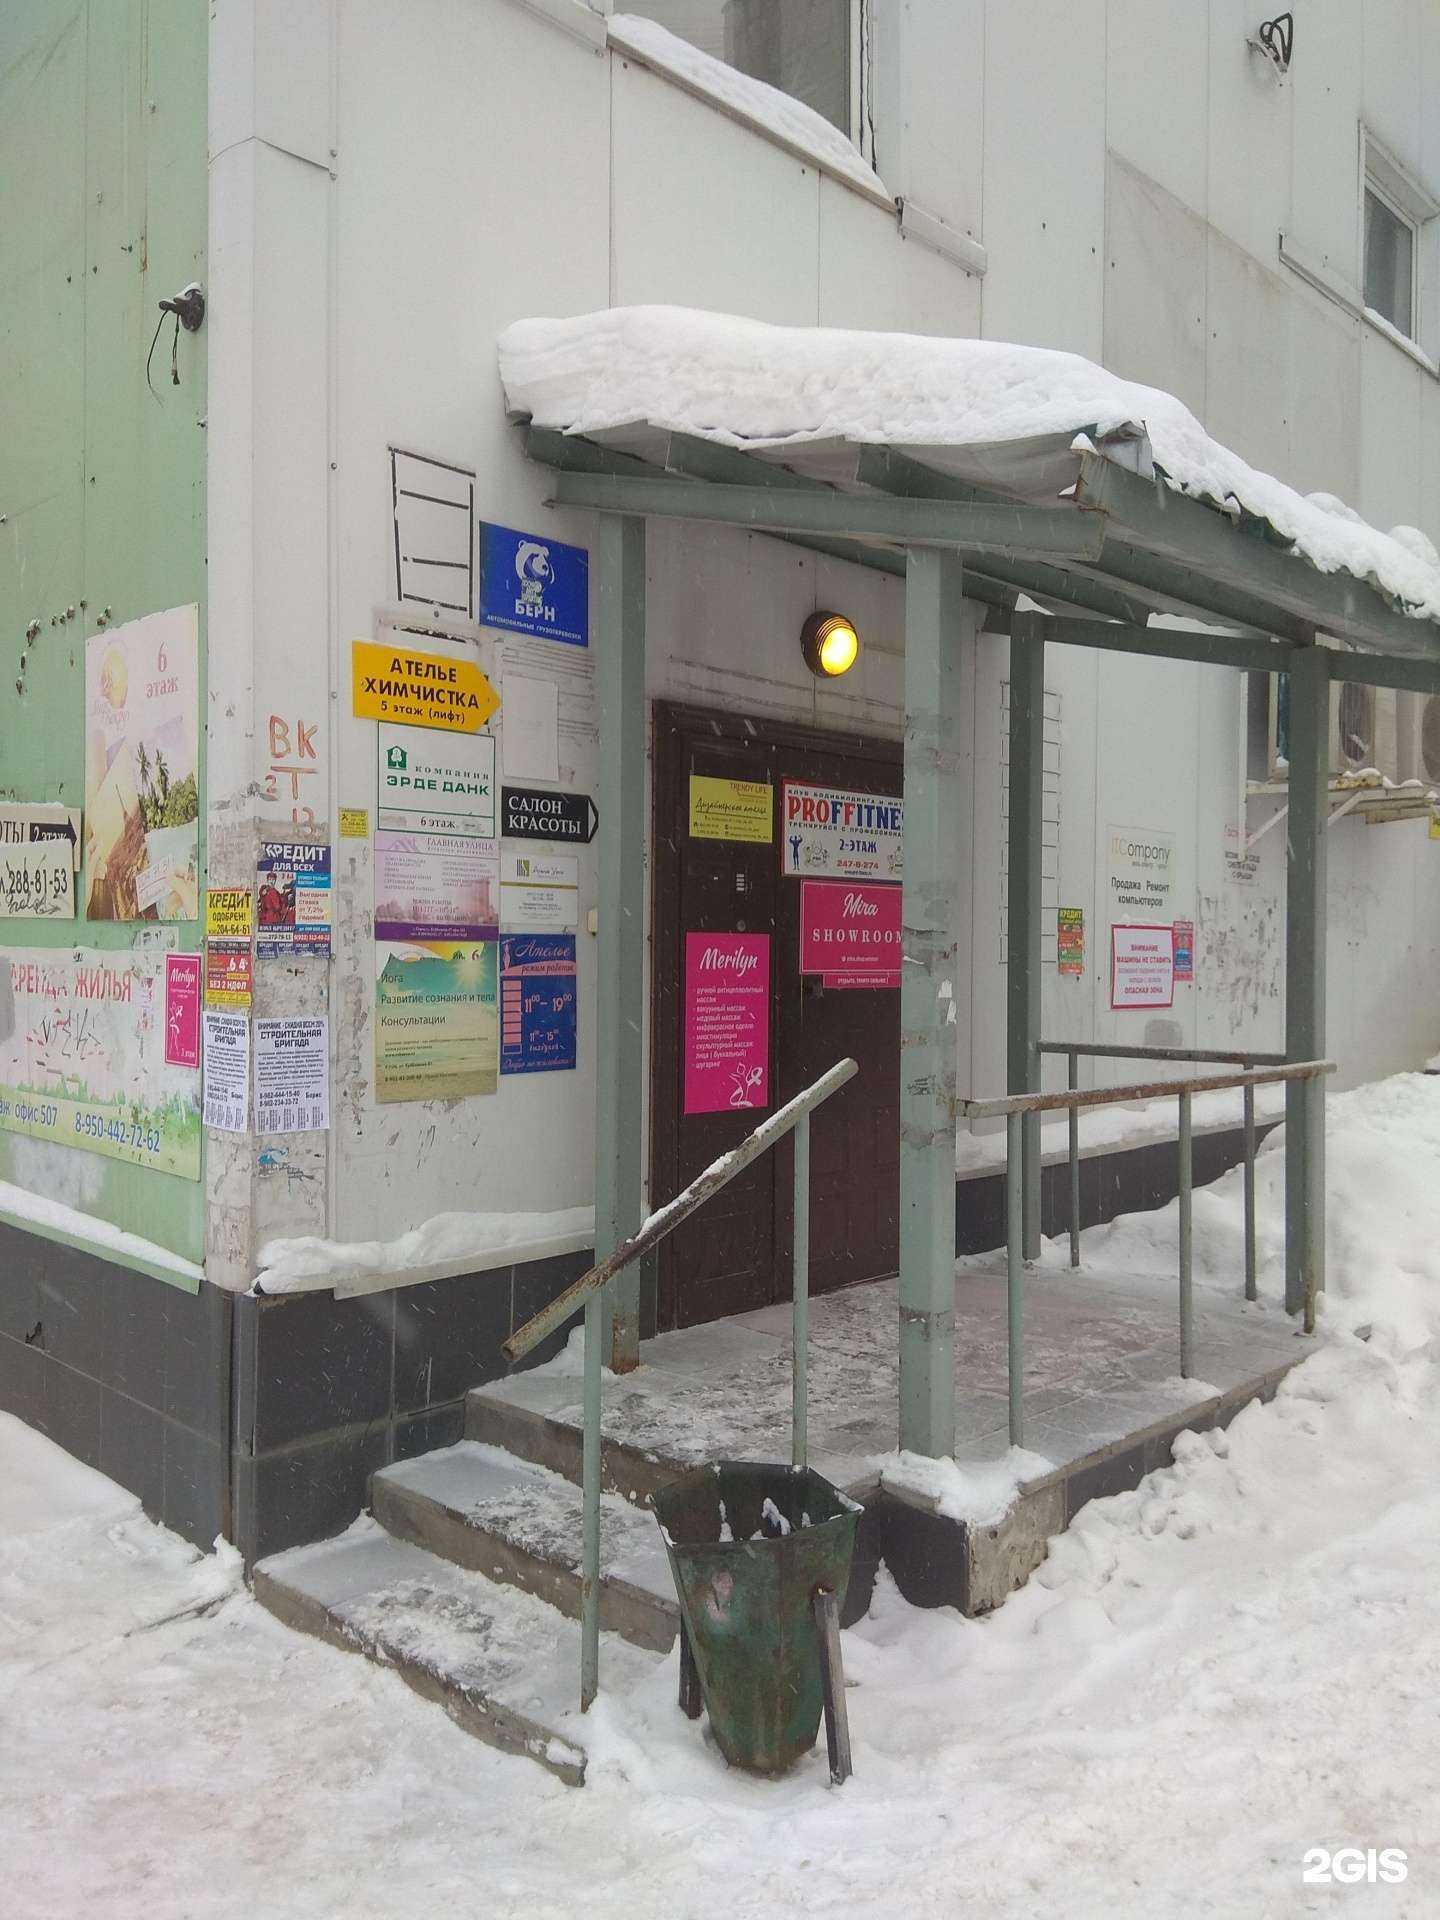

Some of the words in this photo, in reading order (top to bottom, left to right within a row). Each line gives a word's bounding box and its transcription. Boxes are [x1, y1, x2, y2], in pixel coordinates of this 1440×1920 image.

[515, 599, 555, 622] БЕРН
[158, 640, 167, 672] 6
[390, 658, 457, 683] АТЕЛЬЕ
[146, 677, 178, 698] этаж
[365, 677, 479, 709] ХИМЧИСТКА
[381, 700, 388, 711] 5
[393, 704, 424, 716] этаж
[429, 708, 465, 724] (лифт)
[415, 766, 489, 780] компания
[386, 775, 438, 791] ЭРДЕ
[442, 781, 489, 796] ДАНК
[508, 796, 563, 815] САЛОН
[788, 796, 904, 831] PROFFITNE
[0, 821, 25, 843] ТЫ
[420, 816, 427, 826] 6
[429, 819, 455, 829] этаж
[508, 815, 581, 834] КРАСОТЫ
[265, 844, 326, 862] КРЕДИТ
[839, 838, 877, 853] 2-ЭТАЖ
[272, 862, 292, 872] ДЛЯ
[293, 863, 315, 872] ВСЕХ
[1111, 876, 1142, 892] Продажа
[1146, 880, 1170, 893] Ремонт
[209, 893, 251, 911] КРЕДИТ
[843, 893, 879, 918] Mira
[1117, 895, 1163, 909] компьютеров
[212, 912, 246, 922] ОДОБРЕН!
[700, 946, 758, 977] Merilyn
[75, 967, 131, 1002] ЖИЛЬЯ
[170, 967, 196, 989] Merilyn
[381, 972, 404, 984] Йога
[381, 994, 424, 1004] Развитие
[425, 993, 467, 1004] сознания
[469, 994, 476, 1002] и
[477, 993, 495, 1003] тела
[208, 1025, 246, 1037] СТРОИТЕЛЬНАЯ
[381, 1015, 446, 1028] Консультации
[260, 1029, 322, 1039] СТРОИТЕЛЬНАЯ
[274, 1039, 310, 1048] БРИГАДА
[15, 1100, 38, 1124] офис
[40, 1104, 58, 1127] 507
[75, 1111, 160, 1153] 8-950-442-72-62
